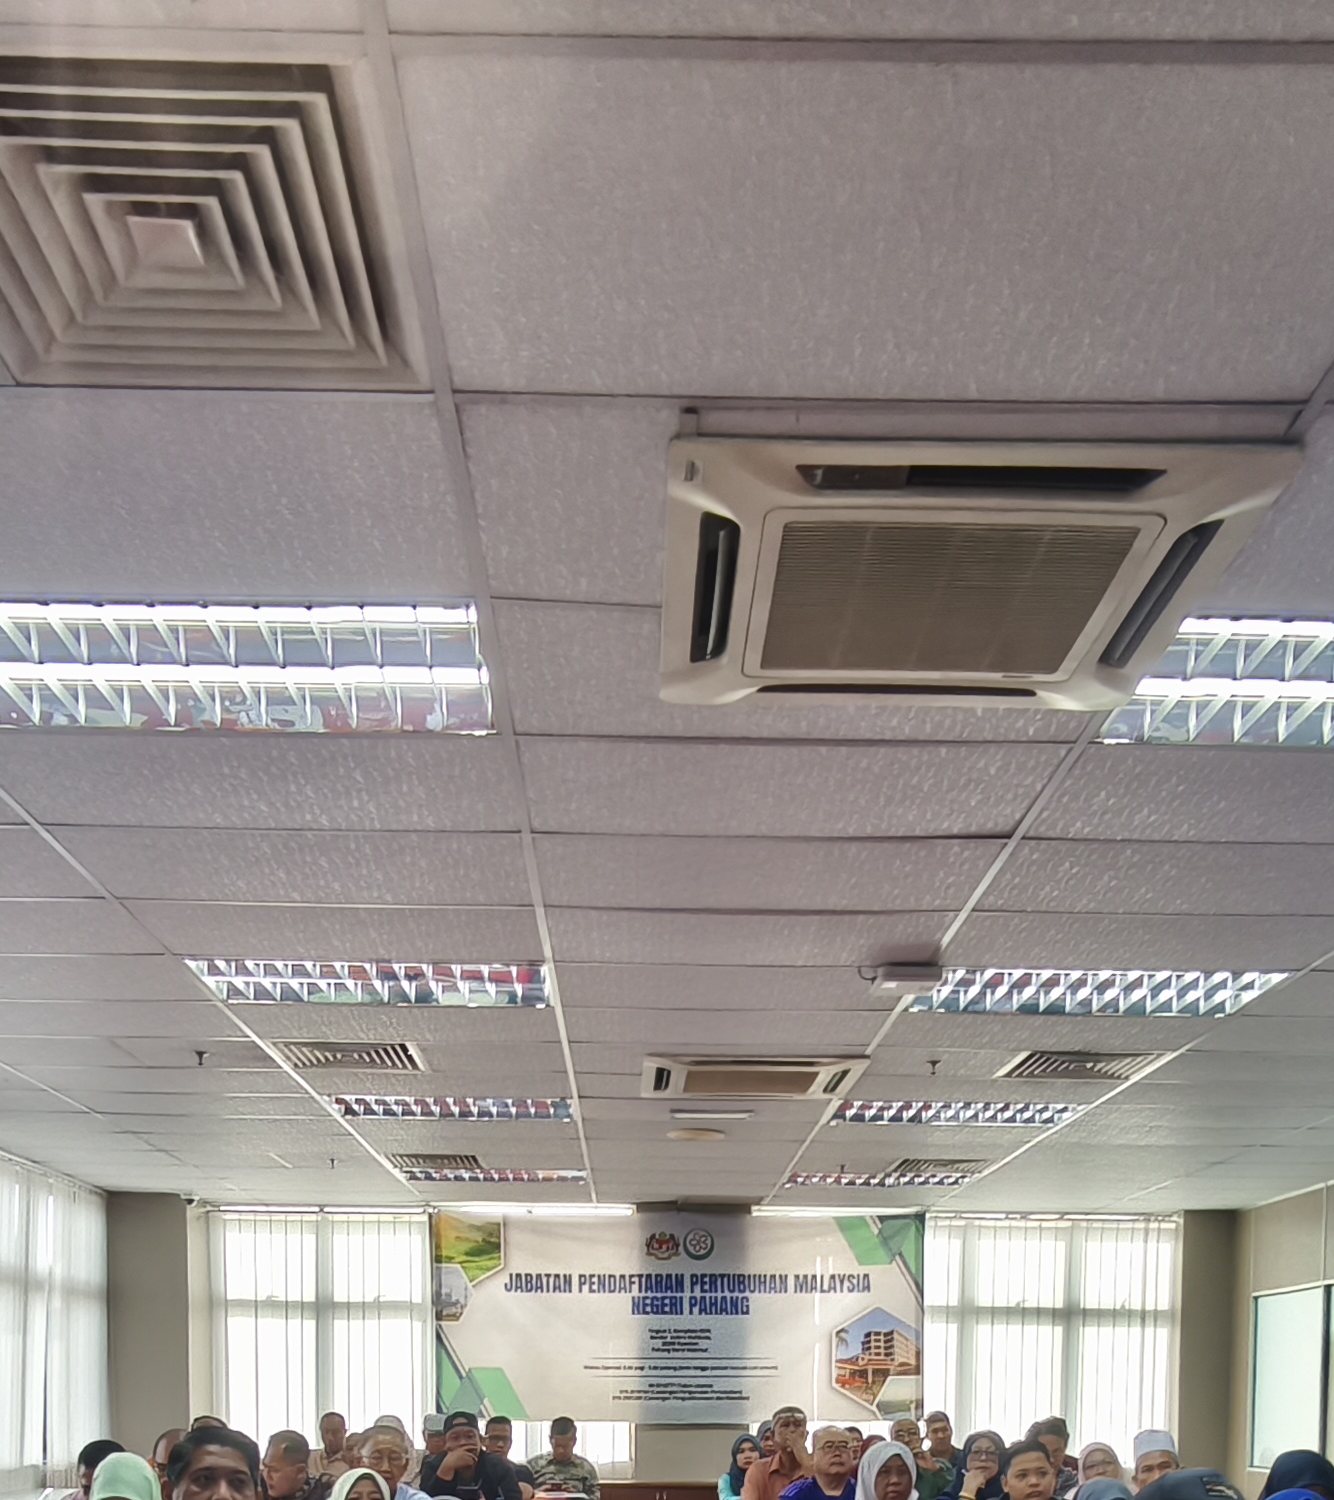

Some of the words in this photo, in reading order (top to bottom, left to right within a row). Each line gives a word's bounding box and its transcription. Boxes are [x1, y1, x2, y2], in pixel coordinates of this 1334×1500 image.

[504, 1272, 573, 1293] JABATAN
[578, 1273, 685, 1294] PENDAFTARAN
[690, 1273, 789, 1294] PERTUBUHAN
[793, 1273, 872, 1294] MALAYSIA
[631, 1296, 684, 1315] NEGERI
[689, 1296, 750, 1315] PAHANG
